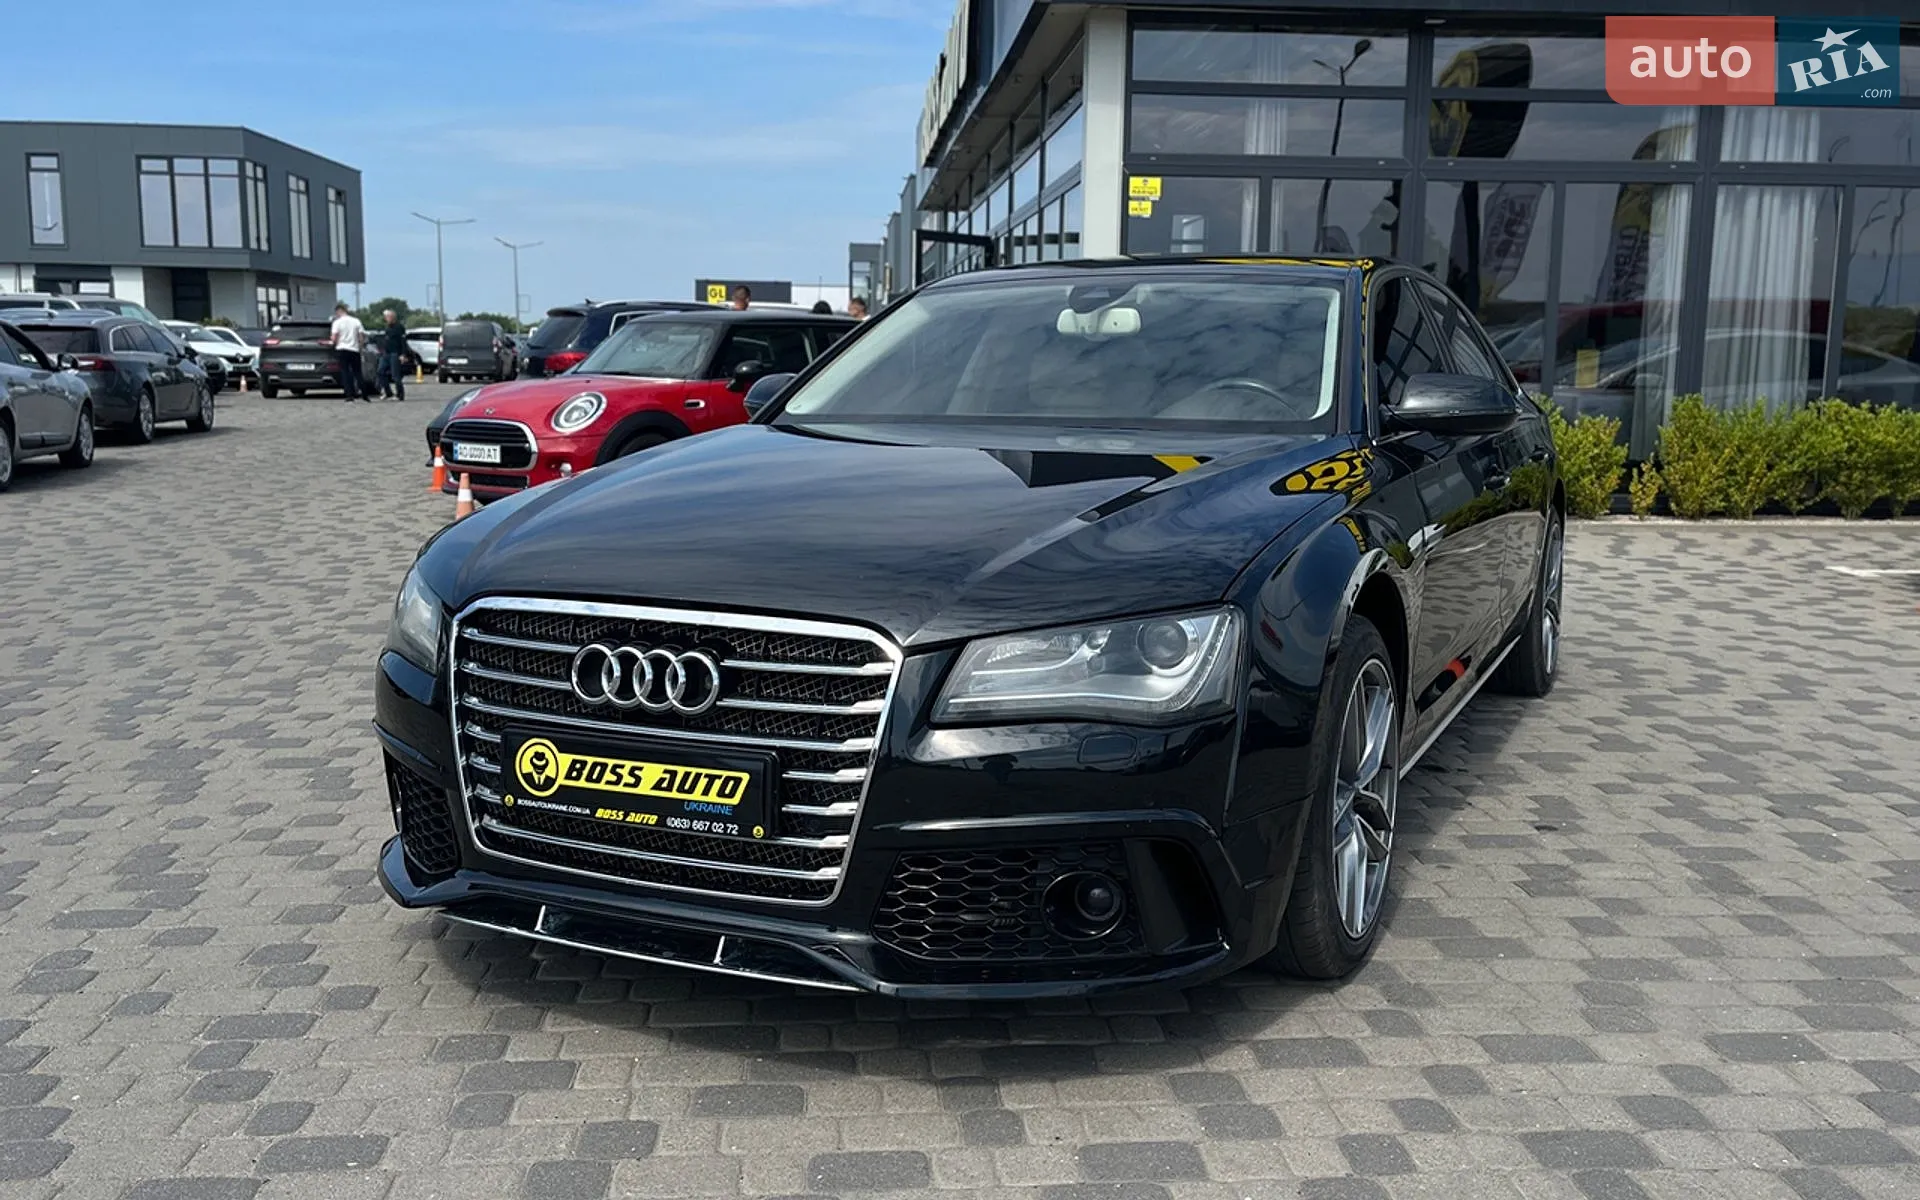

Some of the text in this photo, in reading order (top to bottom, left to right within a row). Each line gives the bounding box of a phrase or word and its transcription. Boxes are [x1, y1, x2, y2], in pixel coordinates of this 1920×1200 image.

[563, 759, 743, 799] BOSS AUTO
[594, 807, 659, 825] BOSS AUTO
[684, 801, 733, 816] UKRAINE
[666, 816, 739, 835] (063) 667 02 72
